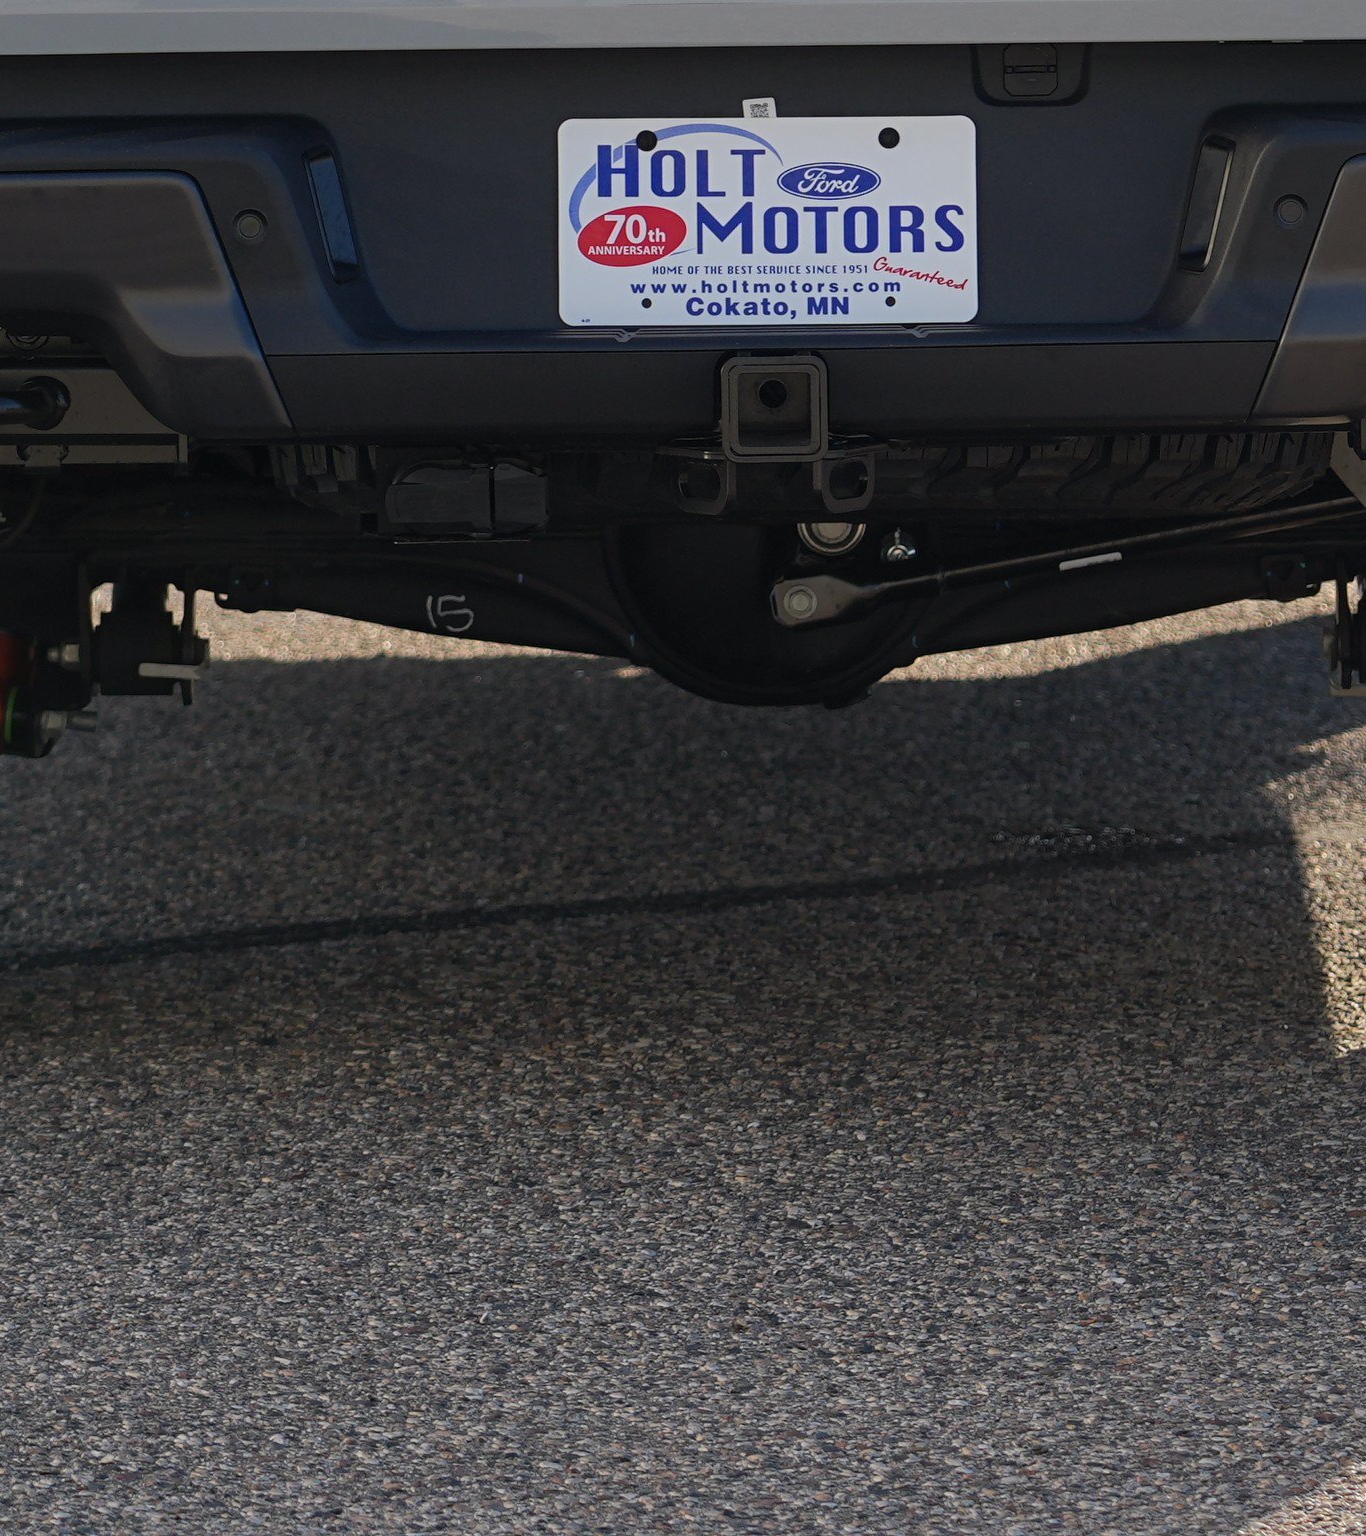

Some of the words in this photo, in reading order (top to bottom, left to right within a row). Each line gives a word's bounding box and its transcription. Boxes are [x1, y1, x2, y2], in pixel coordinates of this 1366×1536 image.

[597, 144, 766, 198] HOLT
[797, 168, 860, 195] Ford
[604, 214, 666, 245] 70th
[696, 202, 965, 255] MOTORS
[587, 244, 666, 258] ANNIVERSARY
[652, 265, 683, 275] HOME
[687, 265, 700, 275] OF
[704, 265, 723, 275] THE
[727, 265, 753, 275] BEST
[756, 265, 801, 275] SERVICE
[805, 265, 837, 274] SINCE
[842, 265, 869, 274] 1951
[873, 256, 968, 291] Guaranteed
[630, 279, 901, 295] www.holtmotors.com
[685, 296, 797, 319] Cokato,
[807, 296, 850, 316] MN
